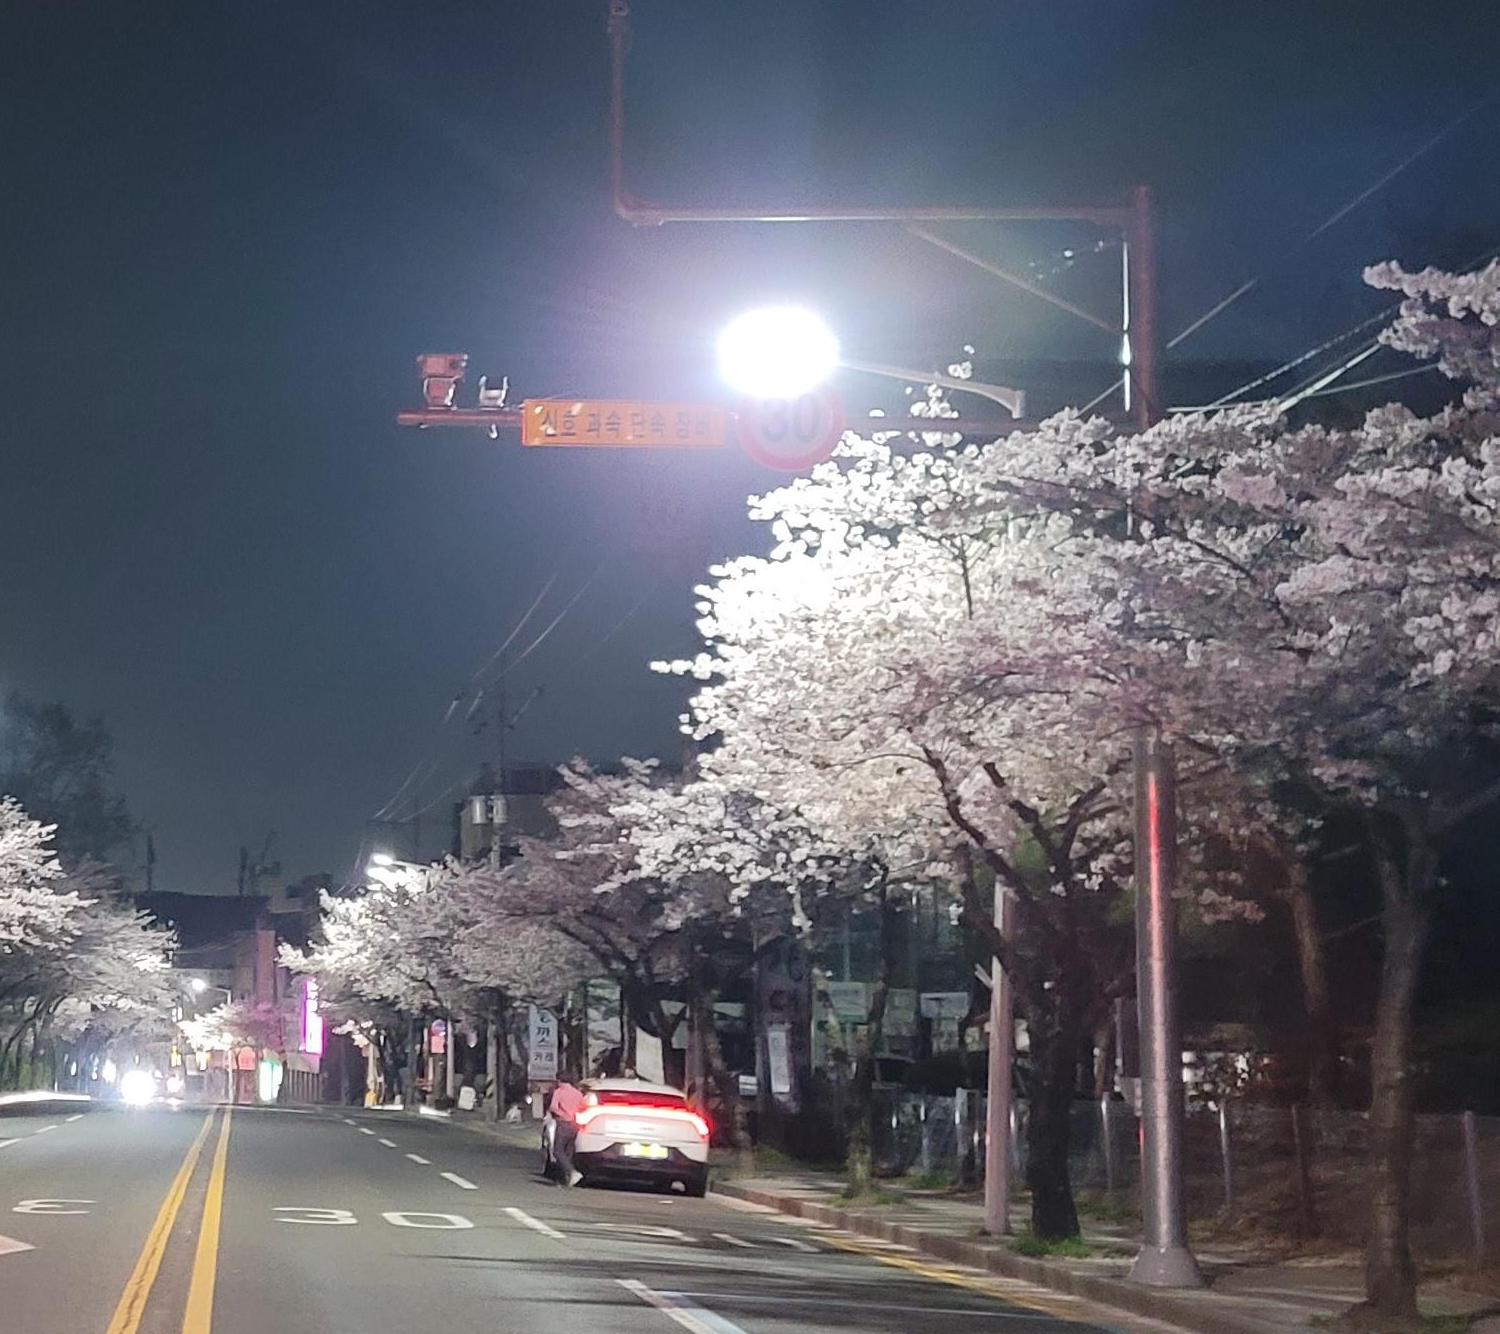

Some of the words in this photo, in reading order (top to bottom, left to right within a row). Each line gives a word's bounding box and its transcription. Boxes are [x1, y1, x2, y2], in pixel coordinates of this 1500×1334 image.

[541, 409, 577, 437] 신호
[586, 410, 621, 438] 과속
[630, 410, 666, 439] 단속
[675, 410, 710, 439] 장비
[761, 394, 820, 443] 30
[271, 1207, 475, 1229] 30
